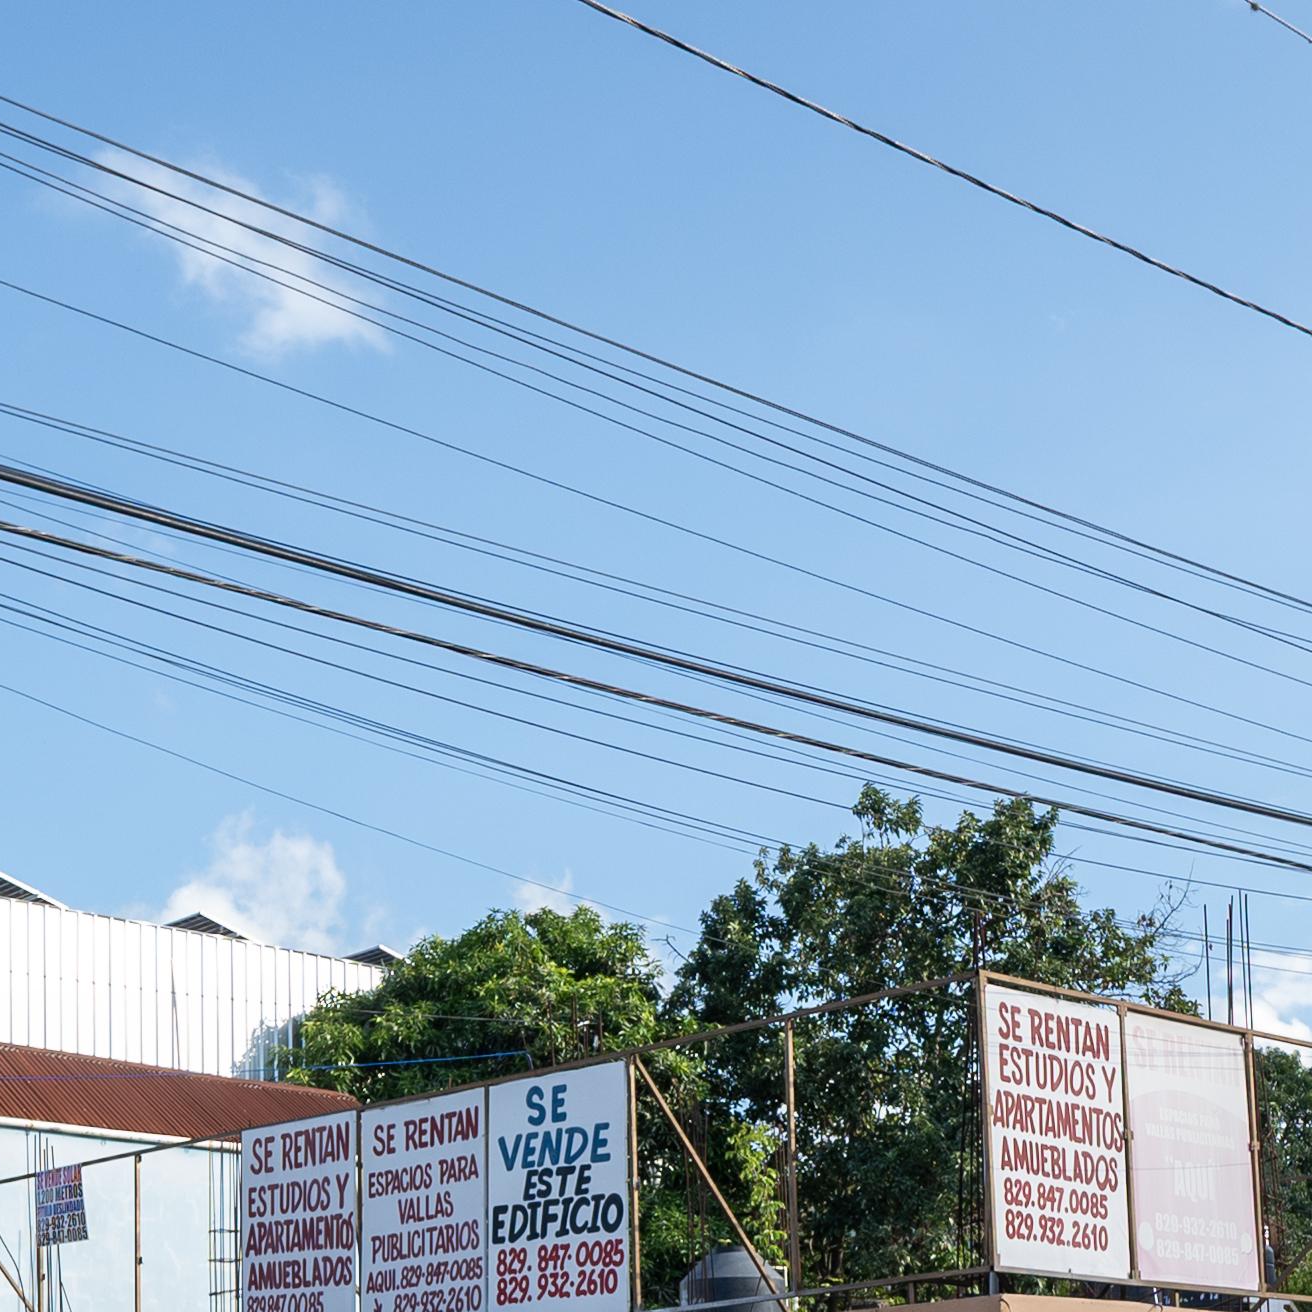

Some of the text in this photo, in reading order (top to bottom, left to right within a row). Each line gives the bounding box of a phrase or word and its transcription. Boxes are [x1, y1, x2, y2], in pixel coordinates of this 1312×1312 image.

[998, 1001, 1110, 1062] SE RENTAN
[999, 1043, 1116, 1103] ESTUDIOS Y
[526, 1084, 567, 1126] SE
[993, 1089, 1123, 1153] APARTAMENTOS
[250, 1121, 350, 1175] SE RENTAN
[373, 1105, 479, 1156] SE RENTAN
[498, 1122, 611, 1172] VENDE
[368, 1154, 479, 1198] ESPACIOS PARA
[523, 1164, 592, 1201] ESTE
[1001, 1136, 1118, 1192] AMUEBLADOS
[55, 1183, 83, 1201] METROS
[248, 1172, 349, 1218] ESTUDIOS Y
[398, 1191, 454, 1225] VALLAS
[1004, 1177, 1108, 1220] 829.847.0085
[245, 1211, 354, 1258] APARTAMENTOS
[371, 1219, 480, 1264] PUBLICITARIOS
[492, 1193, 624, 1244] EDIFICIO
[1005, 1209, 1108, 1252] 829.932.2610
[248, 1256, 352, 1291] AMUEBLADOS
